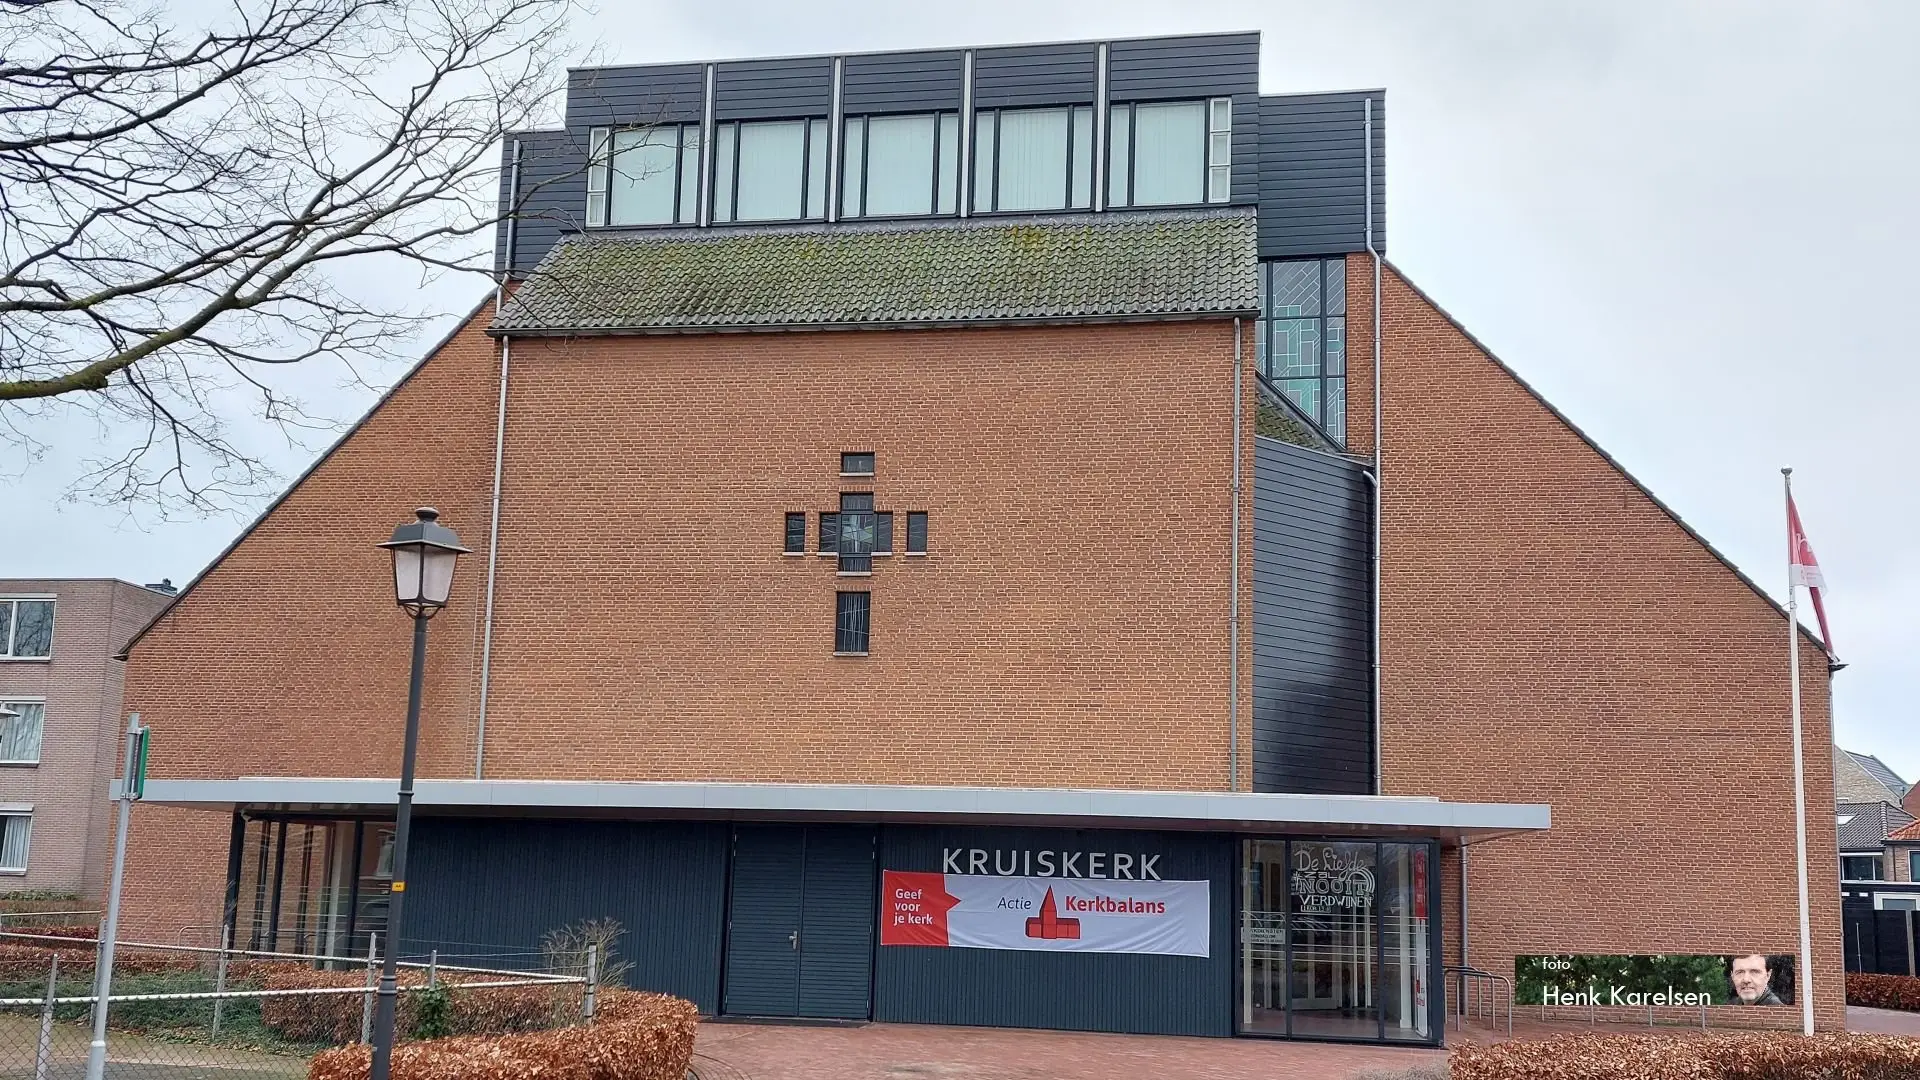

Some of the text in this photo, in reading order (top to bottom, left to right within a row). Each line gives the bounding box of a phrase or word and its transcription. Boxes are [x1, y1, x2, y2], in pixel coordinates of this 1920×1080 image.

[943, 848, 1162, 880] KRUISKERK
[1294, 850, 1320, 872] De
[895, 888, 923, 900] Geef
[1299, 878, 1368, 896] NOOIT
[894, 902, 921, 912] voor
[997, 895, 1166, 914] Actie Kerkbalans
[1299, 894, 1373, 909] VERDWIJNEN
[893, 912, 934, 927] je kerk
